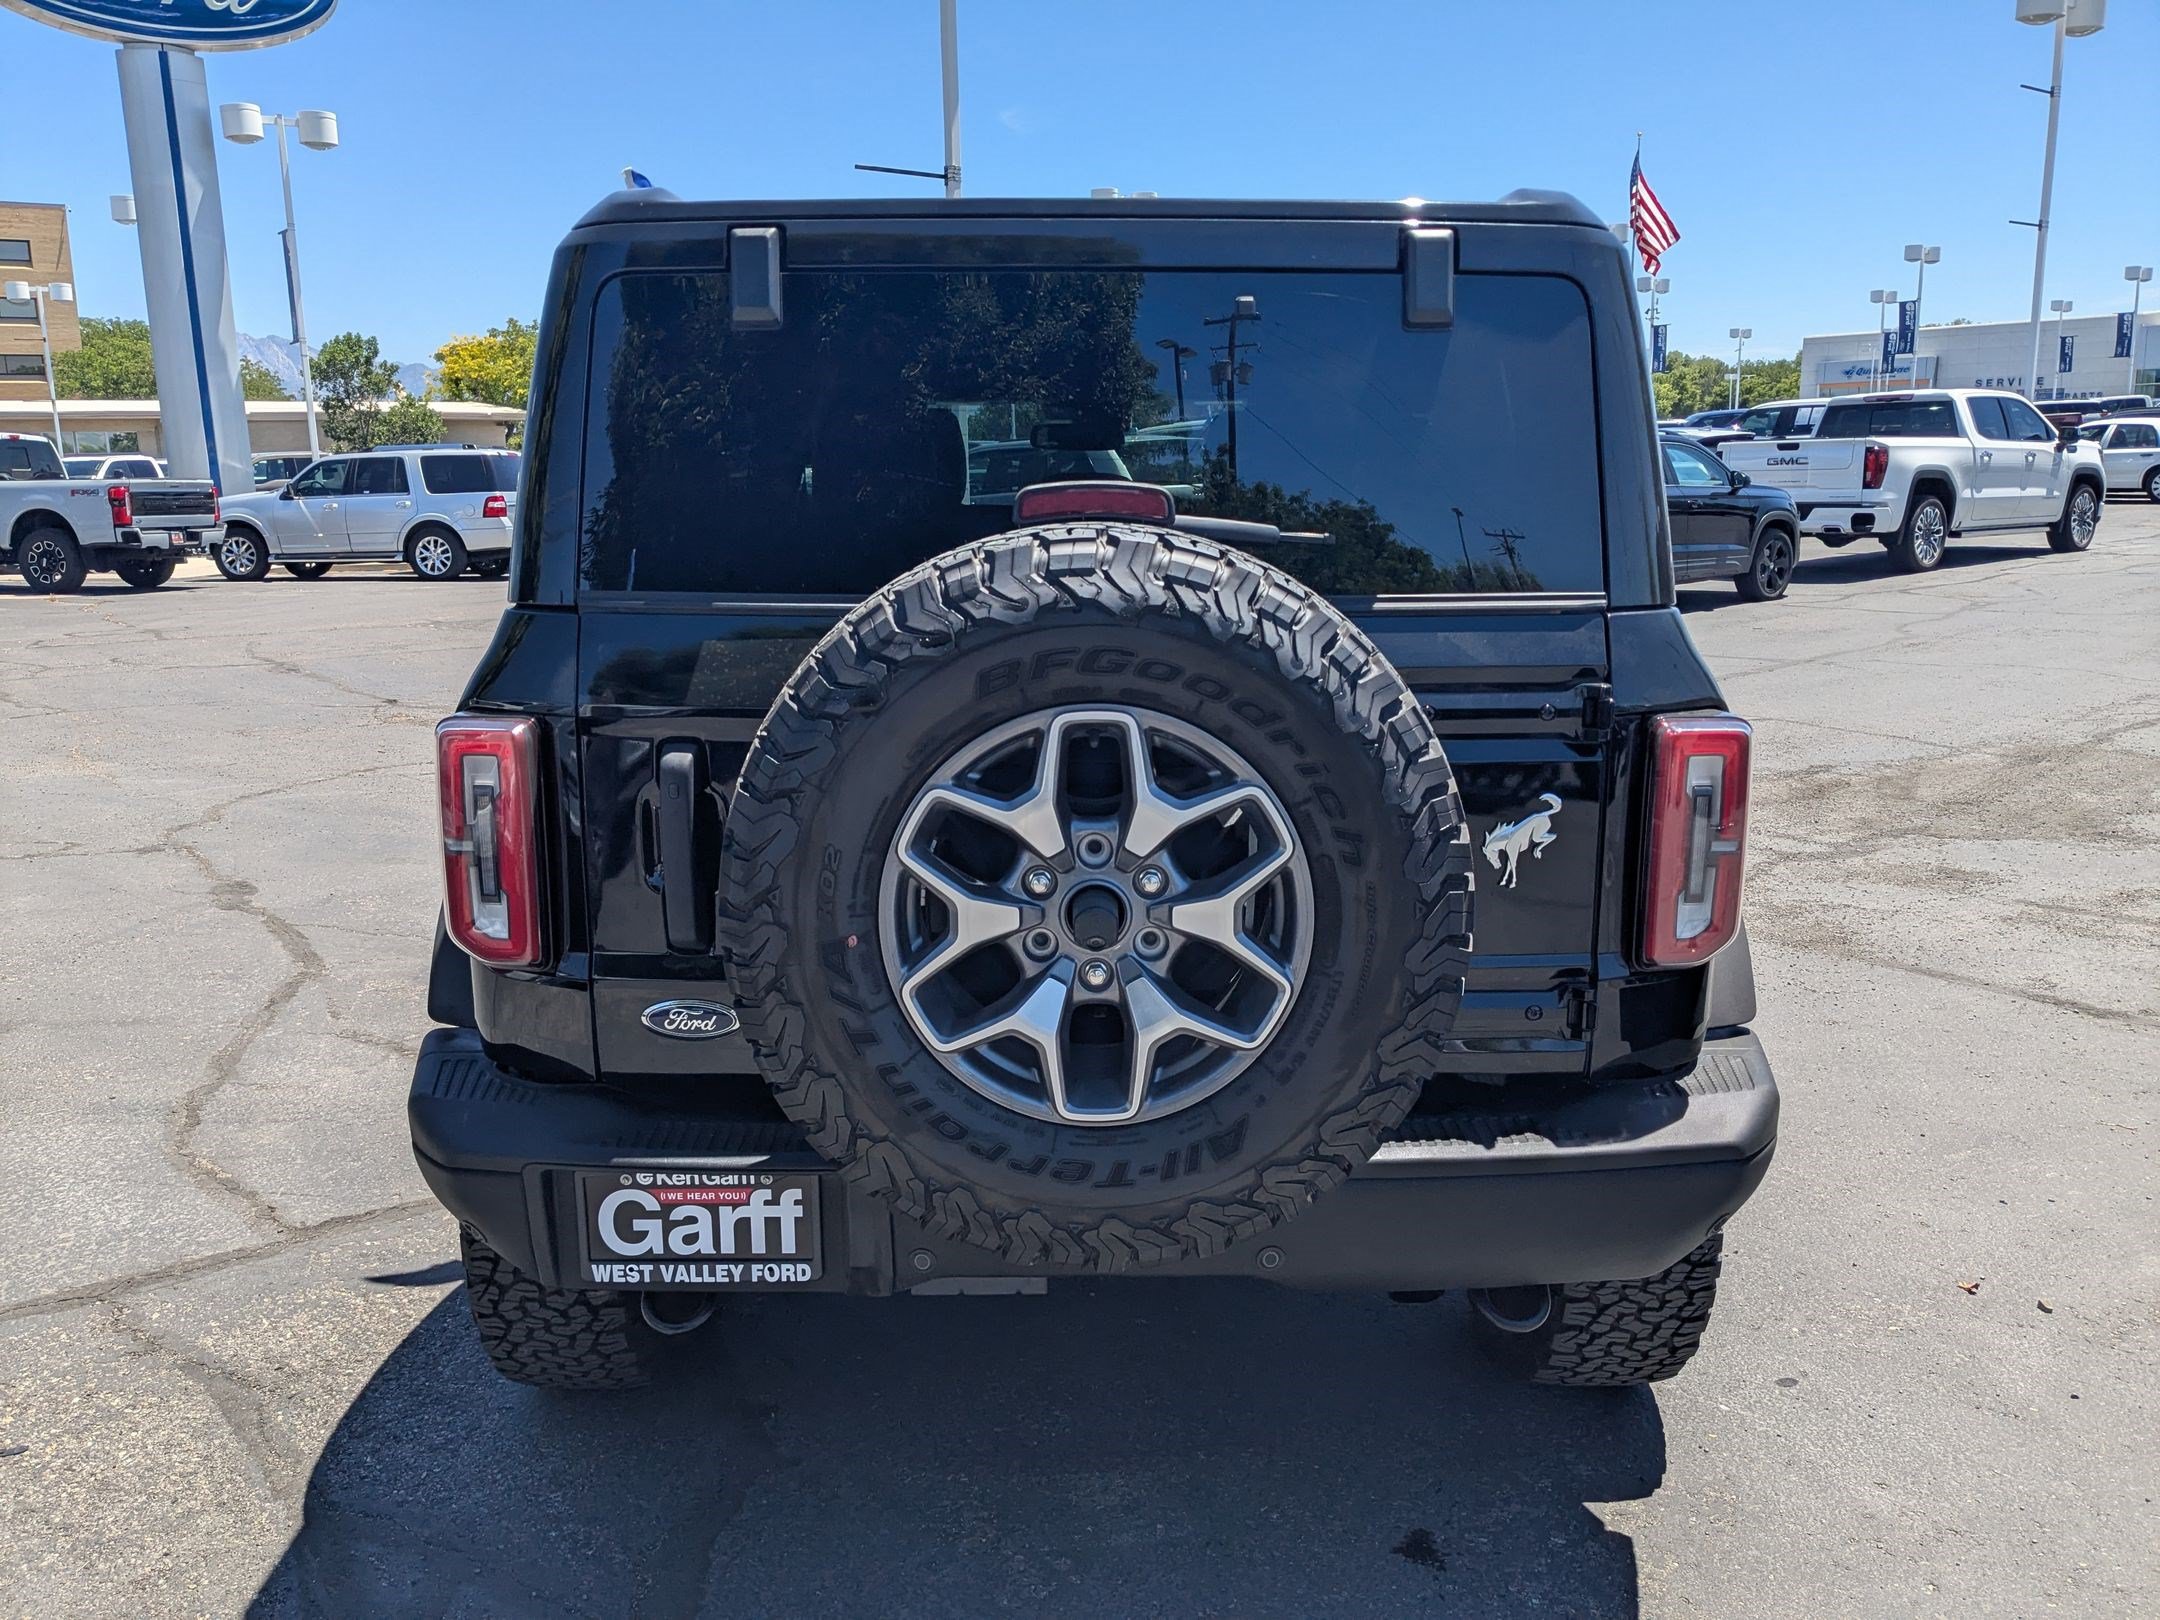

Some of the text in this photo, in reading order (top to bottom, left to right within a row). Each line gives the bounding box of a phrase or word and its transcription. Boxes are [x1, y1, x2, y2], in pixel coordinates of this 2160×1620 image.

[1975, 376, 2044, 388] SERVIE
[1766, 457, 1809, 466] GMC
[973, 645, 1367, 869] BFGoodrich
[664, 1008, 717, 1031] Ford
[668, 1192, 741, 1200] WE HEAR YOU
[597, 1188, 803, 1256] Garff
[591, 1263, 811, 1283] WEST VALLEY FORD
